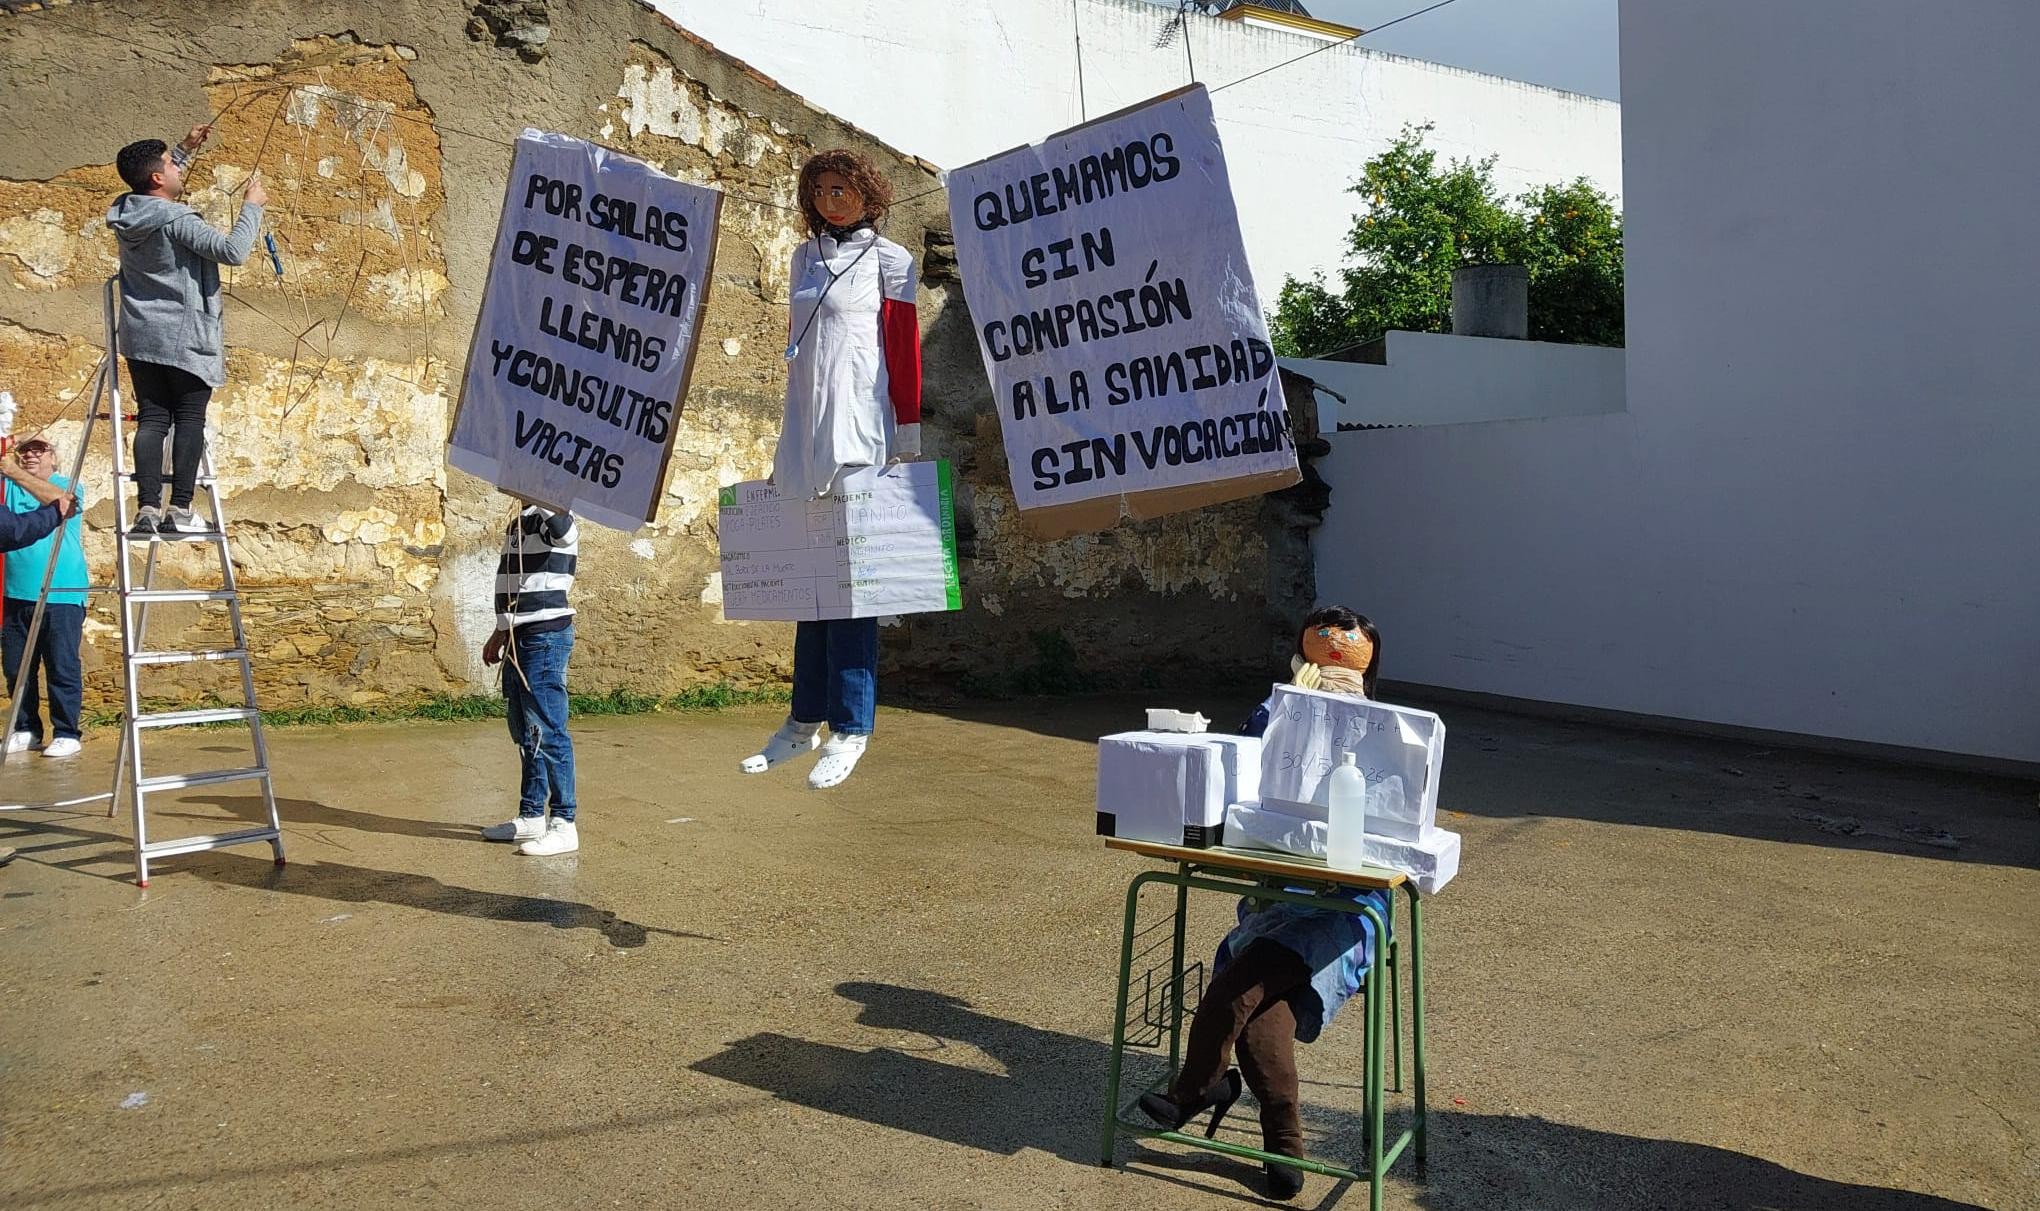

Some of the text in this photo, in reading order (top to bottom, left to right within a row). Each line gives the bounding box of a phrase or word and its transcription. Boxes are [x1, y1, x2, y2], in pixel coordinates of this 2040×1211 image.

[524, 174, 688, 252] POR SALAS
[973, 133, 1180, 231] QUEMAMOS
[511, 230, 687, 317] DE ESPERA
[1021, 227, 1115, 288] SIN
[540, 297, 666, 373] LLENAS
[984, 260, 1192, 362] COMPASIÓN
[491, 339, 673, 444] Y CONSULTAS
[1013, 338, 1273, 420] A LA SANIDAD
[515, 410, 625, 488] VACIAS
[1031, 388, 1295, 490] SIN VOCACIÓN
[833, 492, 873, 504] PACIENTE
[944, 548, 956, 588] RECETA
[1284, 705, 1303, 721] NO
[1313, 708, 1340, 726] HAY
[1349, 715, 1385, 732] CTA
[1334, 737, 1348, 748] EL
